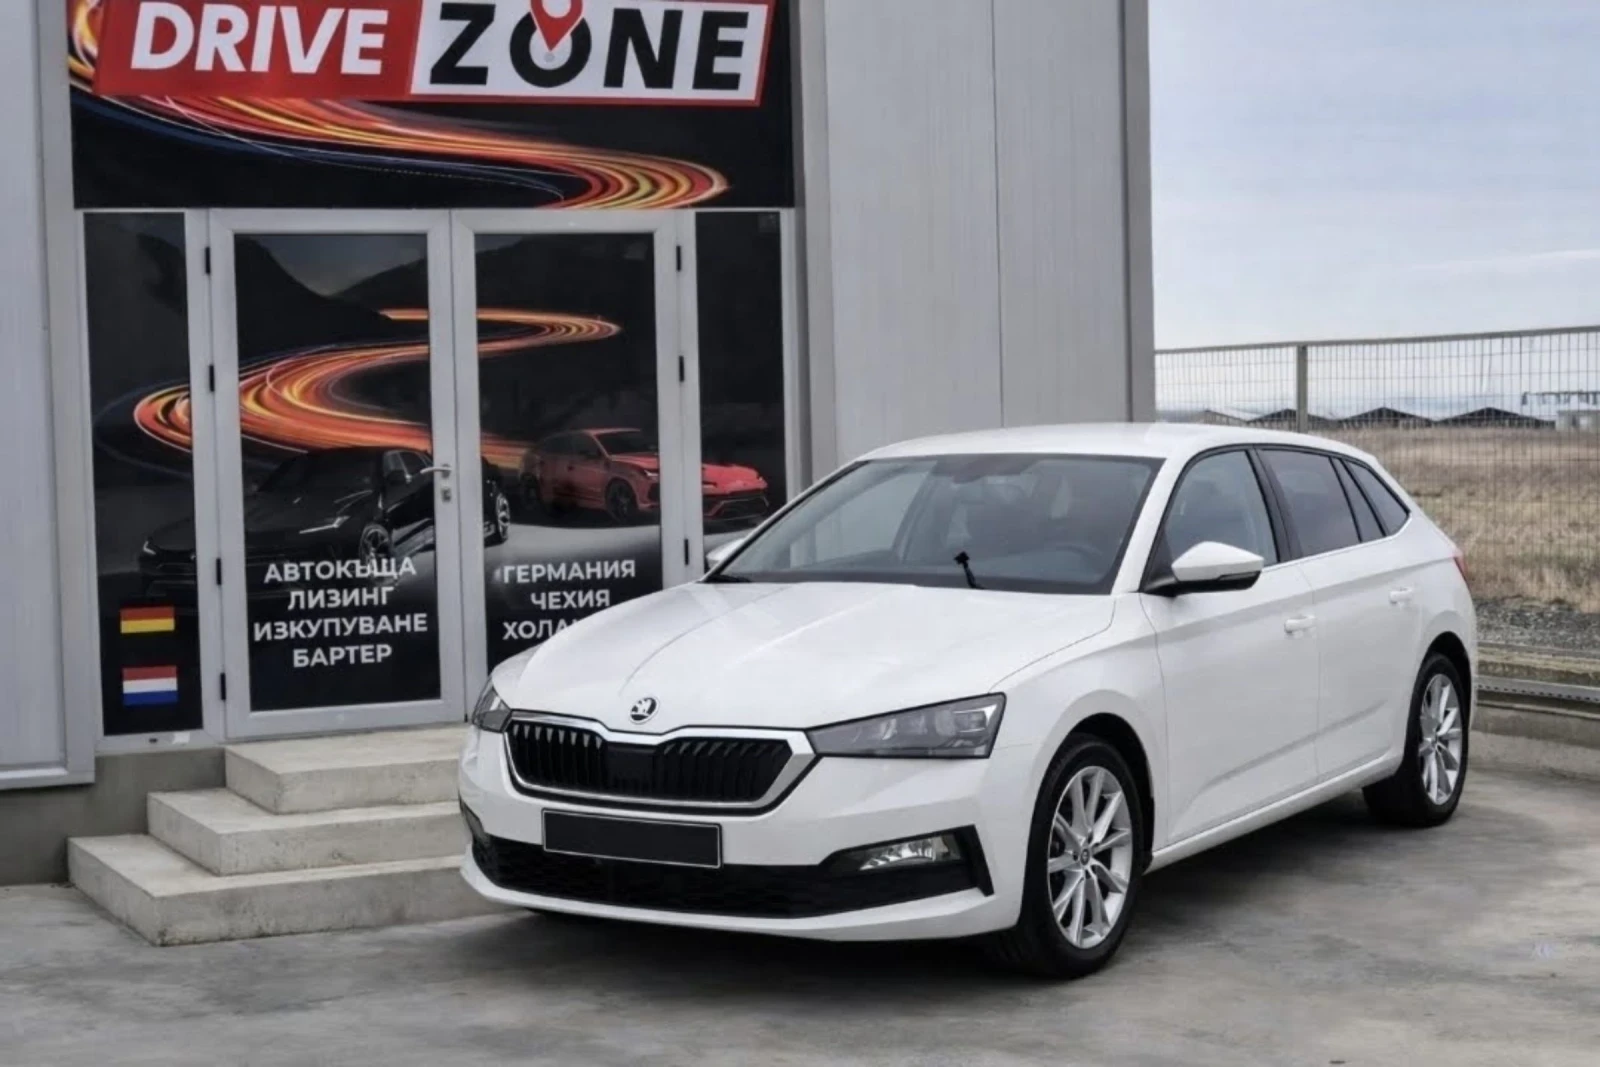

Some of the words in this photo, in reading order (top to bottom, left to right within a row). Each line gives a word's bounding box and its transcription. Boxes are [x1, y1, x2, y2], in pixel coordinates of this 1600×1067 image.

[130, 1, 389, 75] DRIVE
[429, 2, 750, 91] ZONE
[263, 556, 417, 584] АВТОКЪЩА
[503, 559, 636, 583] ГЕРМАНИЯ
[287, 586, 395, 610] ЛИЗИНГ
[530, 589, 610, 610] ЧЕХИЯ
[253, 613, 428, 642] ИЗКУПУВАНЕ
[502, 618, 580, 640] ХОЛА
[293, 644, 393, 668] БАРТЕР
